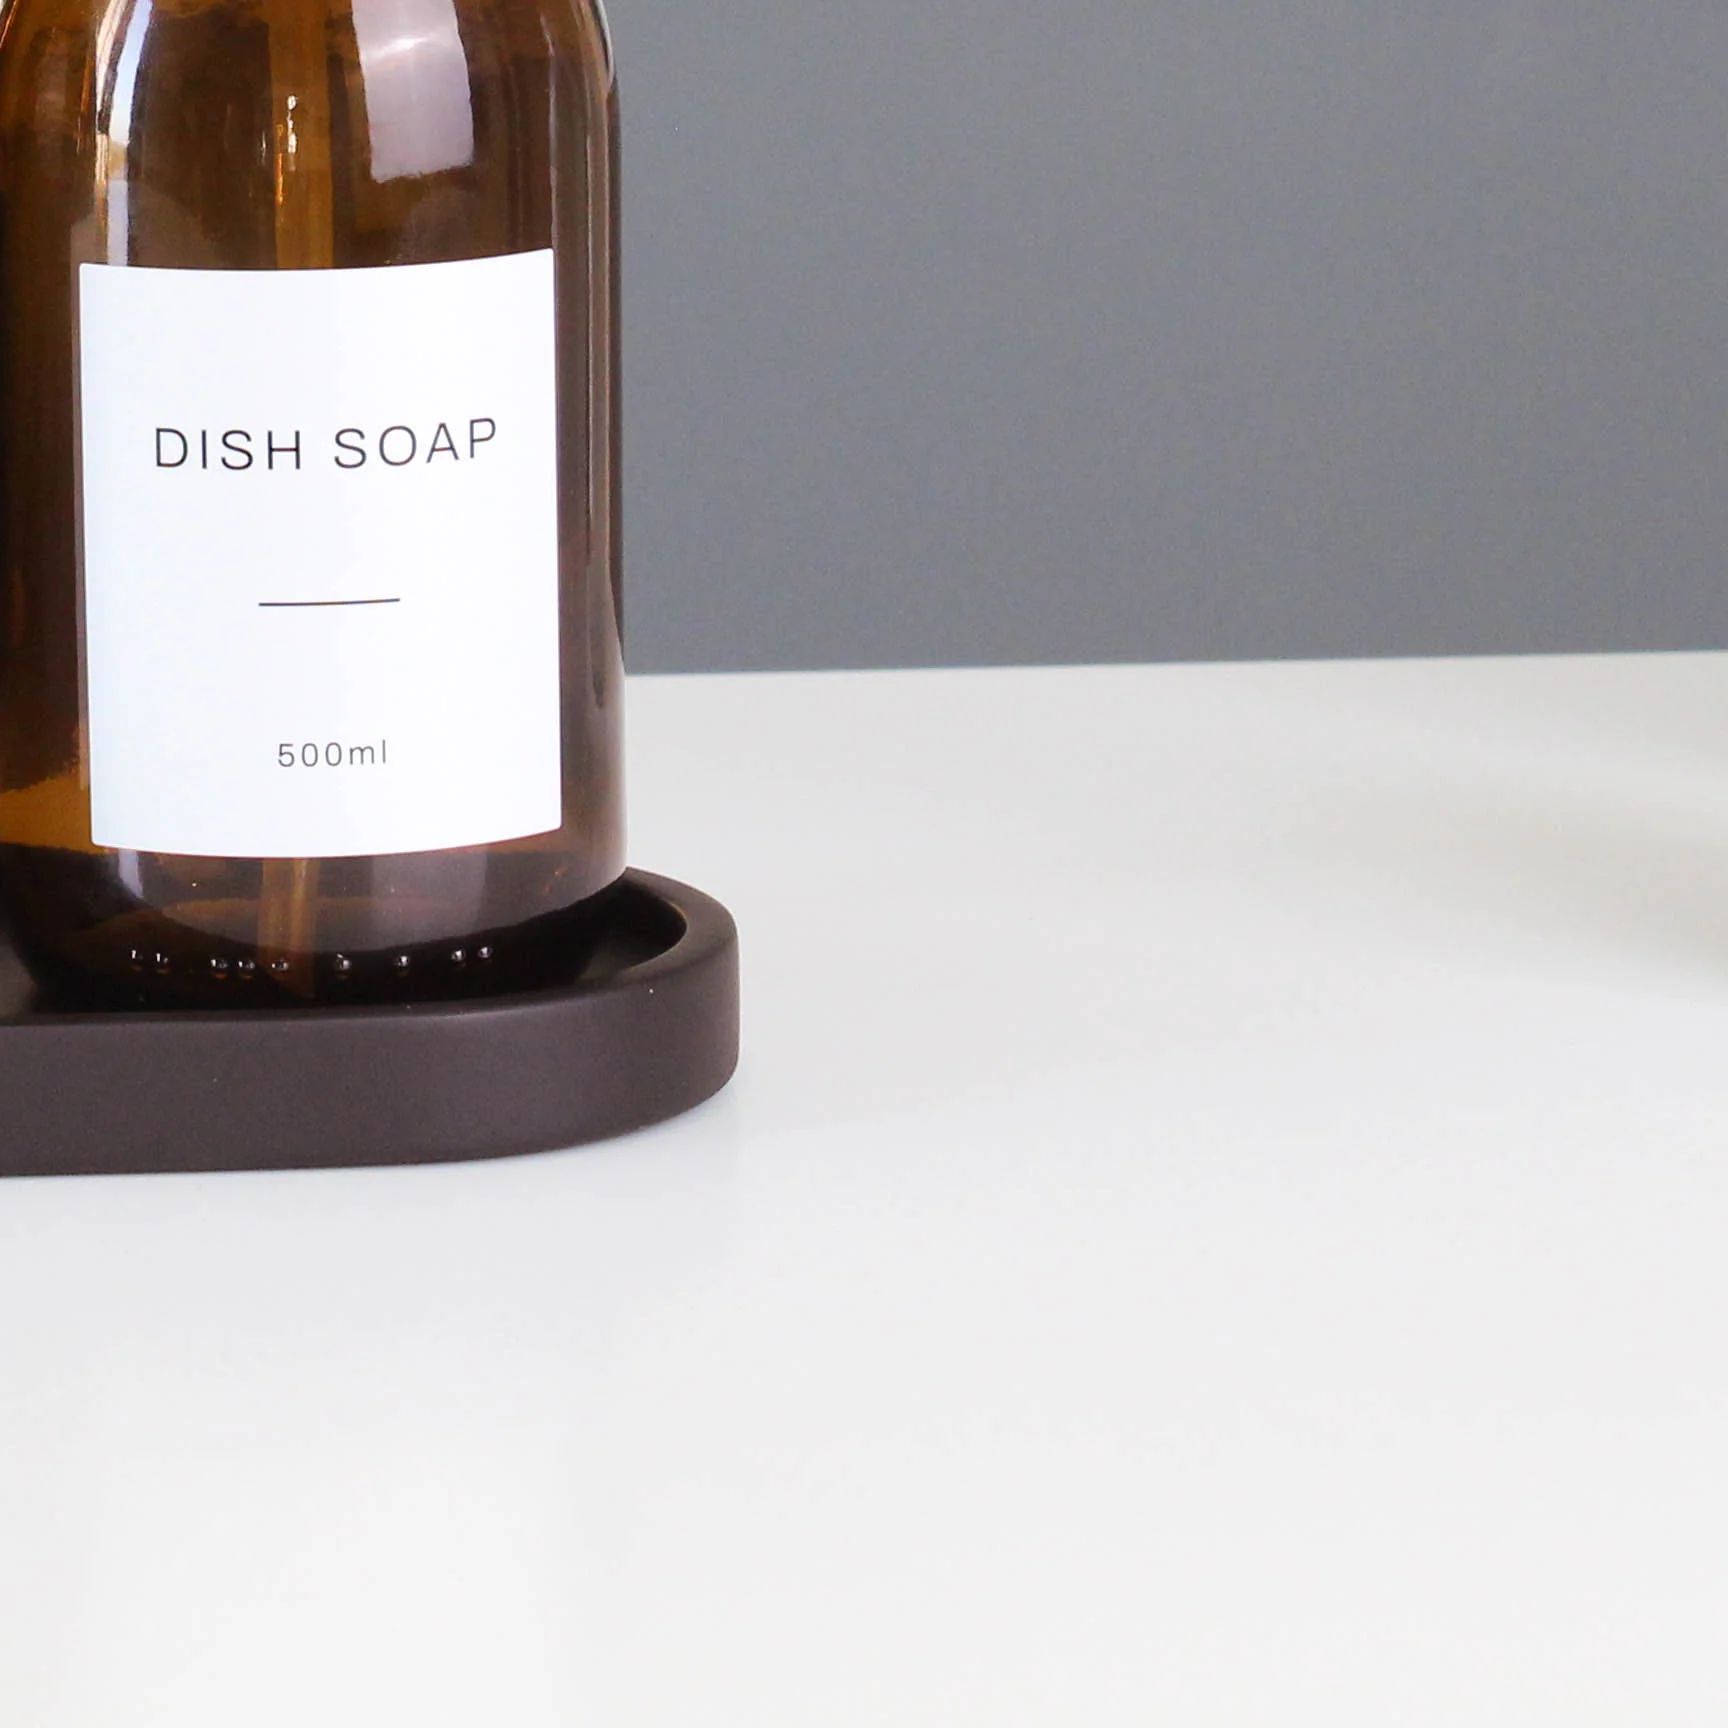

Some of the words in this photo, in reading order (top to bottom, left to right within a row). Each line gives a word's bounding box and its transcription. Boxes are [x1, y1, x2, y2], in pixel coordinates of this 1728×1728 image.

[155, 427, 301, 471] DISH
[334, 417, 497, 469] SOAP
[278, 739, 387, 768] 500ml
